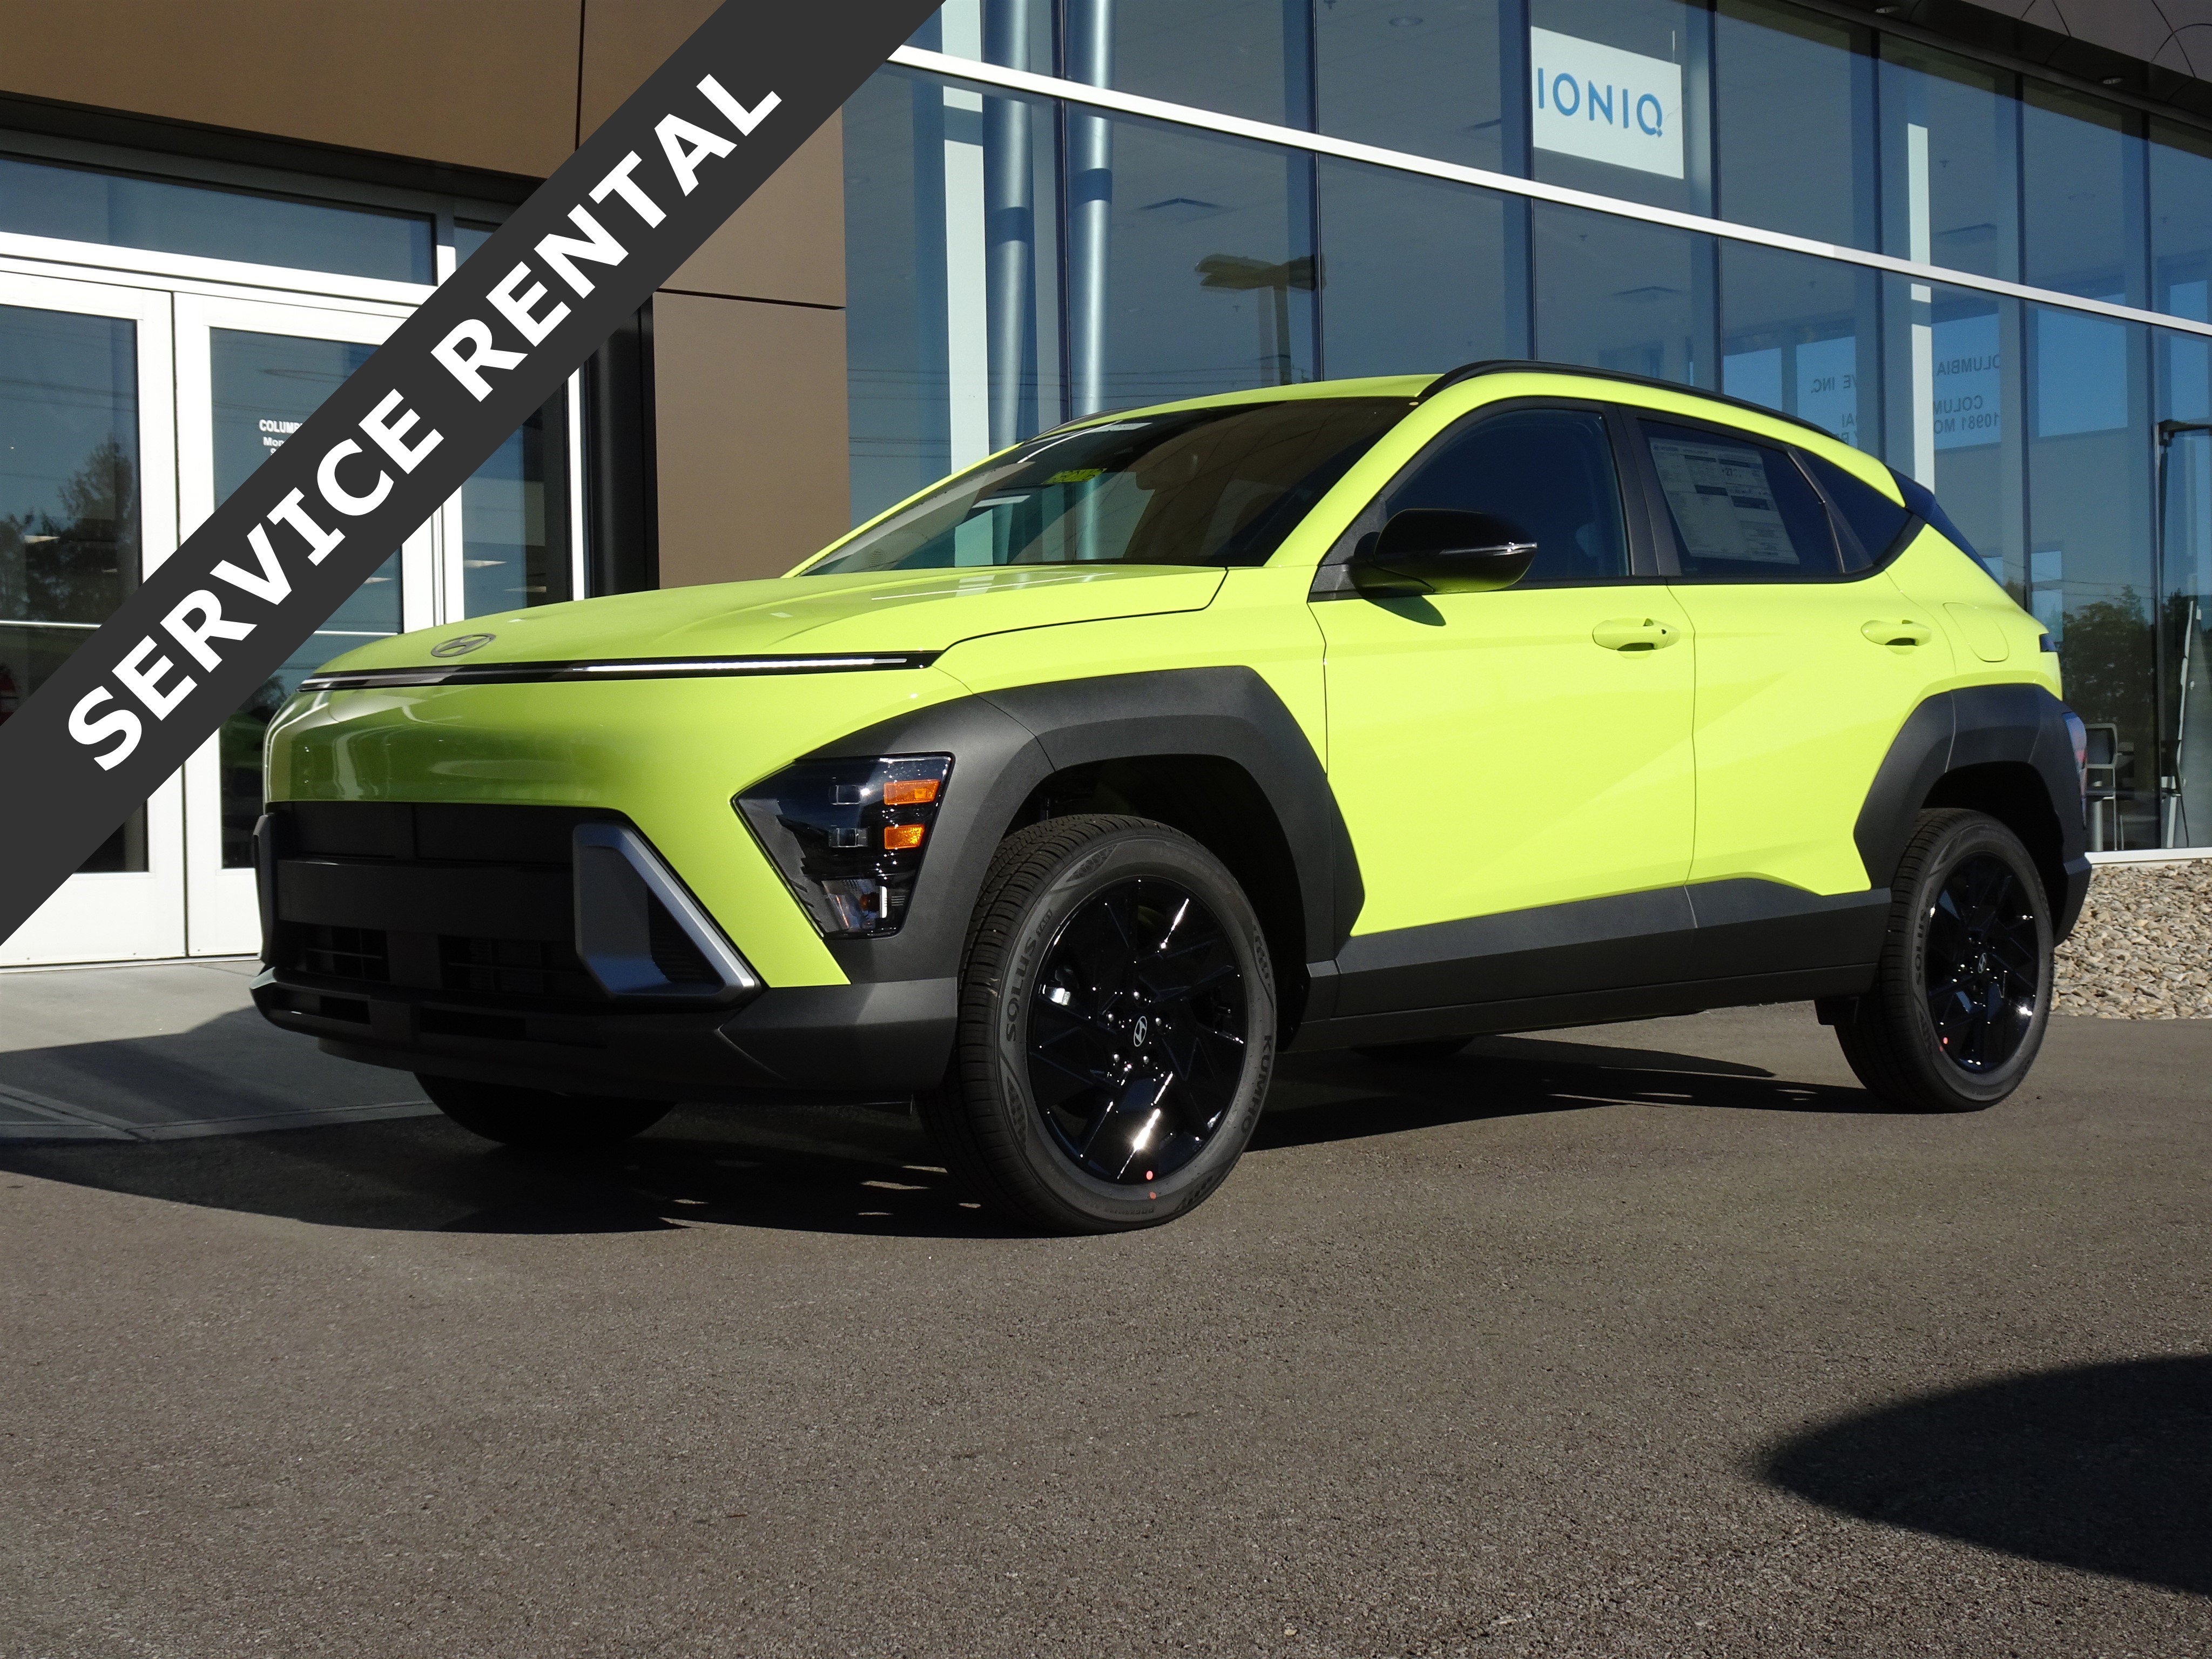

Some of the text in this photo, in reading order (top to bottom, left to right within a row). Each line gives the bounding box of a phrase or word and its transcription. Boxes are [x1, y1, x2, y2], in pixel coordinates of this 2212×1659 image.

[1537, 68, 1663, 138] IONIQ
[1006, 936, 1036, 1042] SOLUS
[1242, 1035, 1271, 1133] KUMHO
